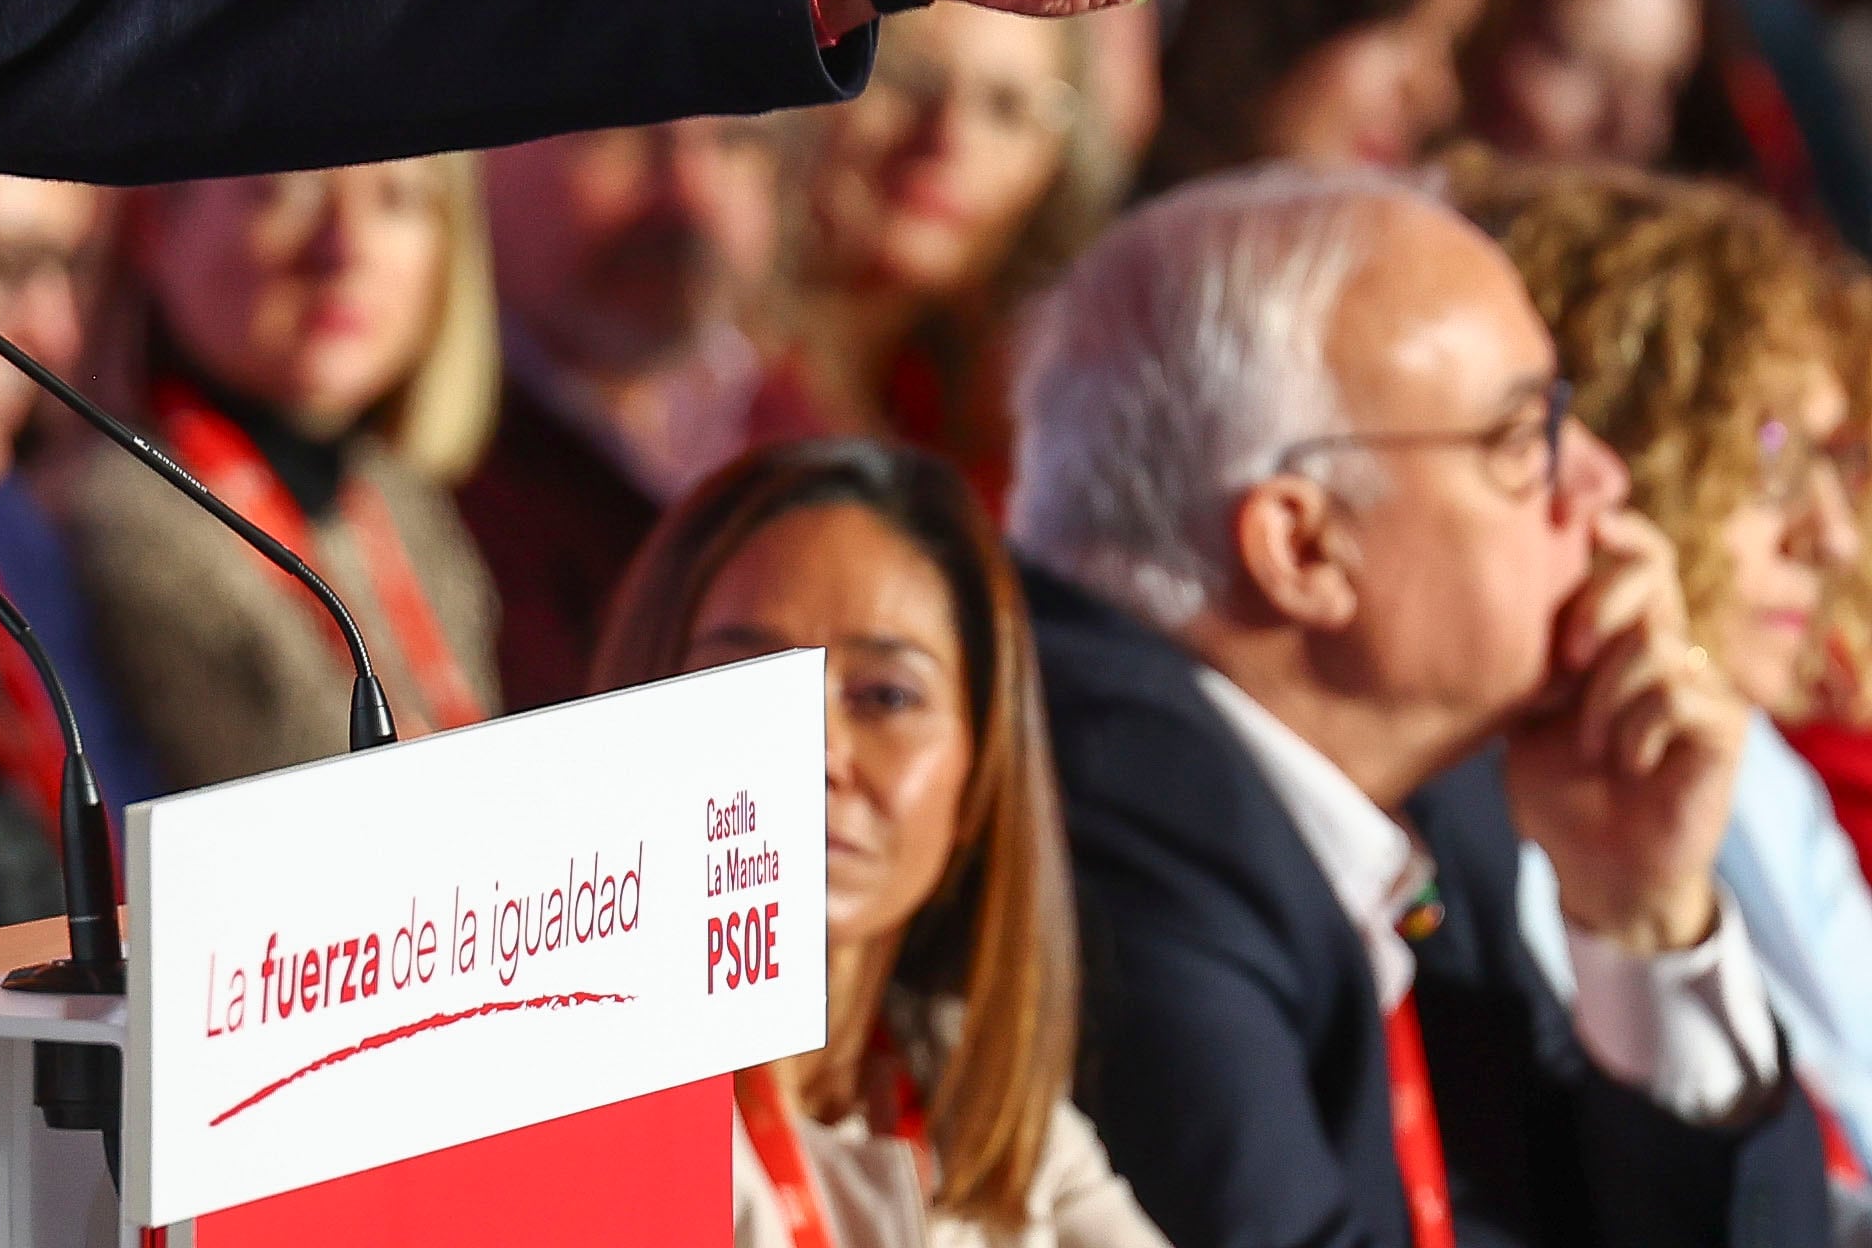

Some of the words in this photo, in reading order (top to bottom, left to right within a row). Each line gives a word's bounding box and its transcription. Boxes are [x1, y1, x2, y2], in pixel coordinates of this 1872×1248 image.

[706, 789, 756, 843] Castilla
[706, 853, 723, 899] La
[726, 839, 780, 894] Mancha
[206, 953, 247, 1039] La
[260, 932, 381, 1025] fuerza
[391, 897, 437, 991] de
[450, 885, 477, 977] la
[491, 840, 644, 988] igualdad
[707, 900, 780, 996] PSOE
